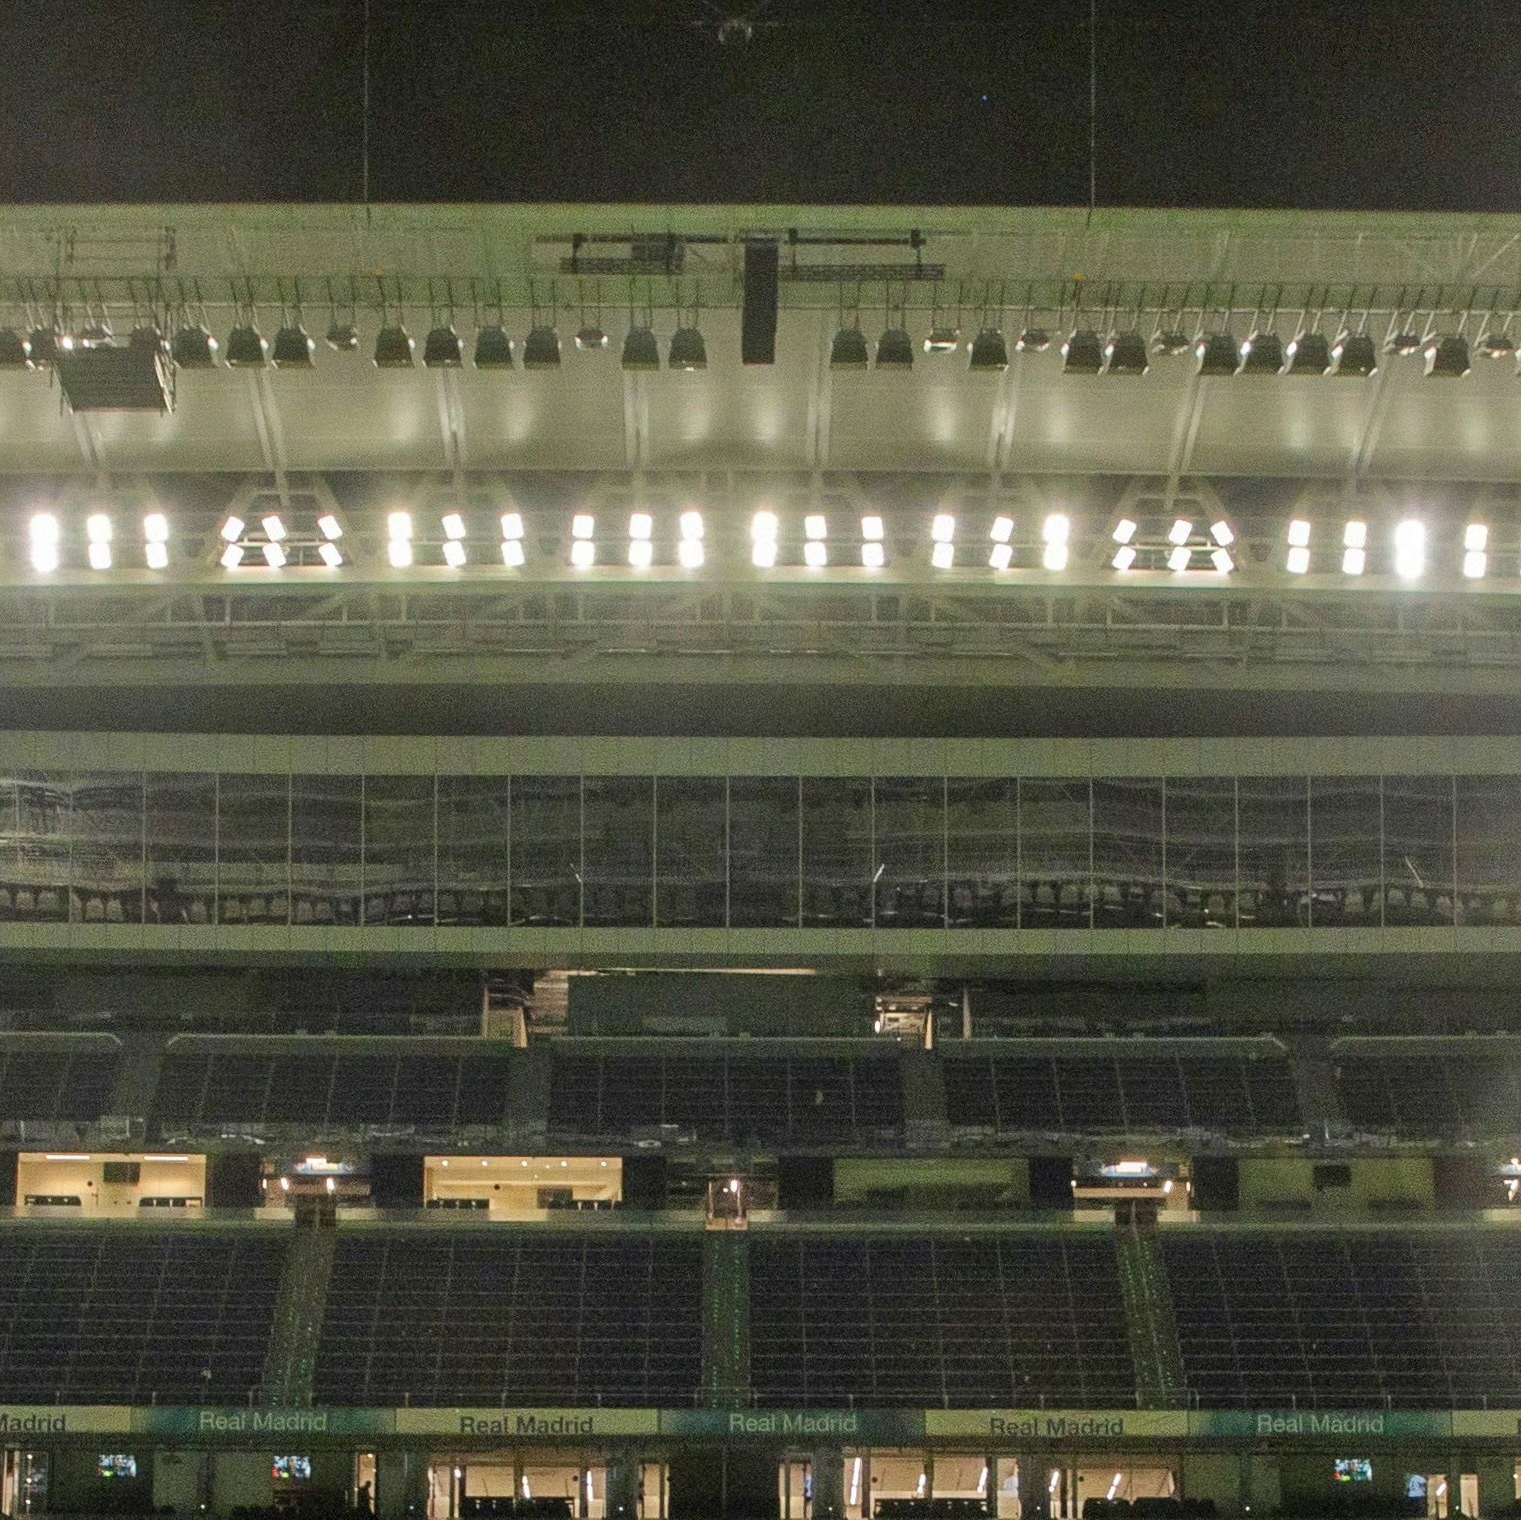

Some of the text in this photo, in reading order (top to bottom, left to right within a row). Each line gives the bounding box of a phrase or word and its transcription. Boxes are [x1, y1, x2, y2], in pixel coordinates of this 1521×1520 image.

[199, 1411, 327, 1431] Real Madrid
[460, 1416, 593, 1434] Real Madrid
[729, 1413, 857, 1432] Real Madrid
[990, 1418, 1123, 1436] Real Madrid
[1257, 1414, 1384, 1433] Real Madrid
